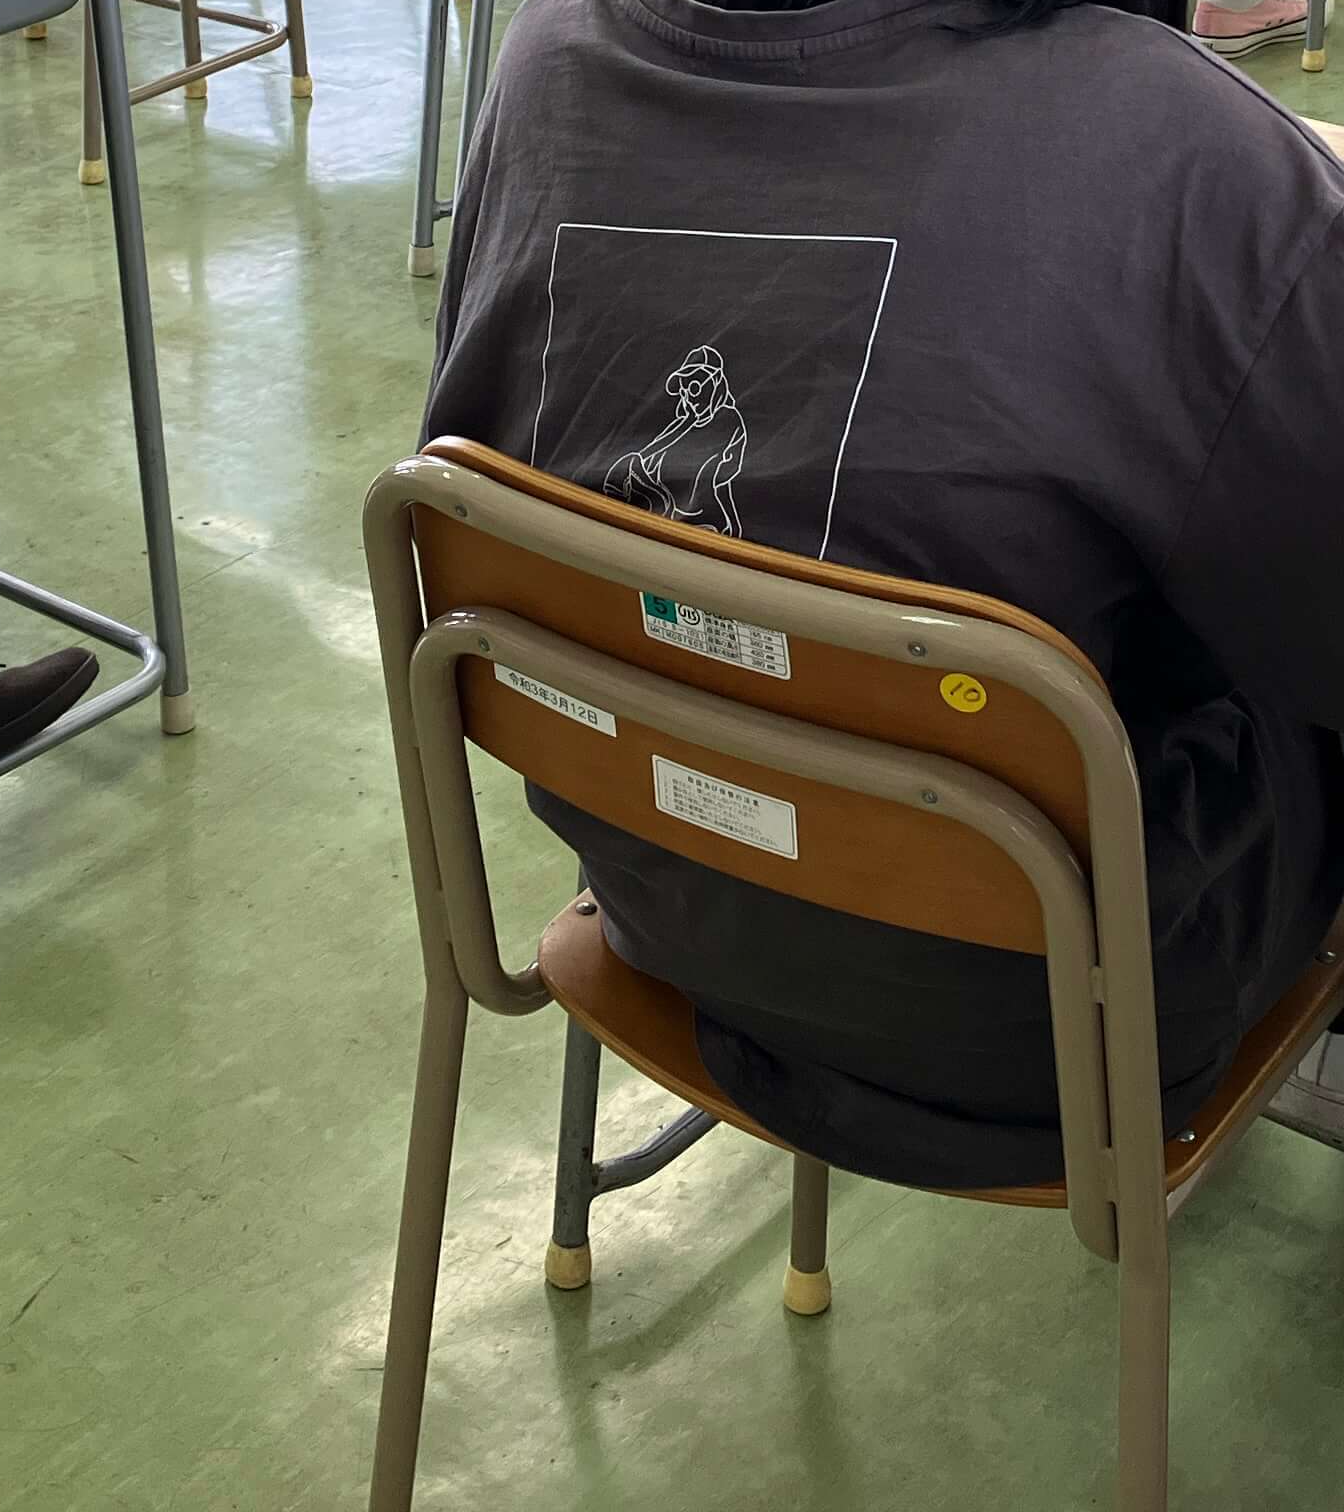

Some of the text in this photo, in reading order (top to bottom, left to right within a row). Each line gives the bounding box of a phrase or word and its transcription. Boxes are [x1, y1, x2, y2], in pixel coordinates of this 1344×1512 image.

[509, 672, 598, 725] 令和3年3月12日
